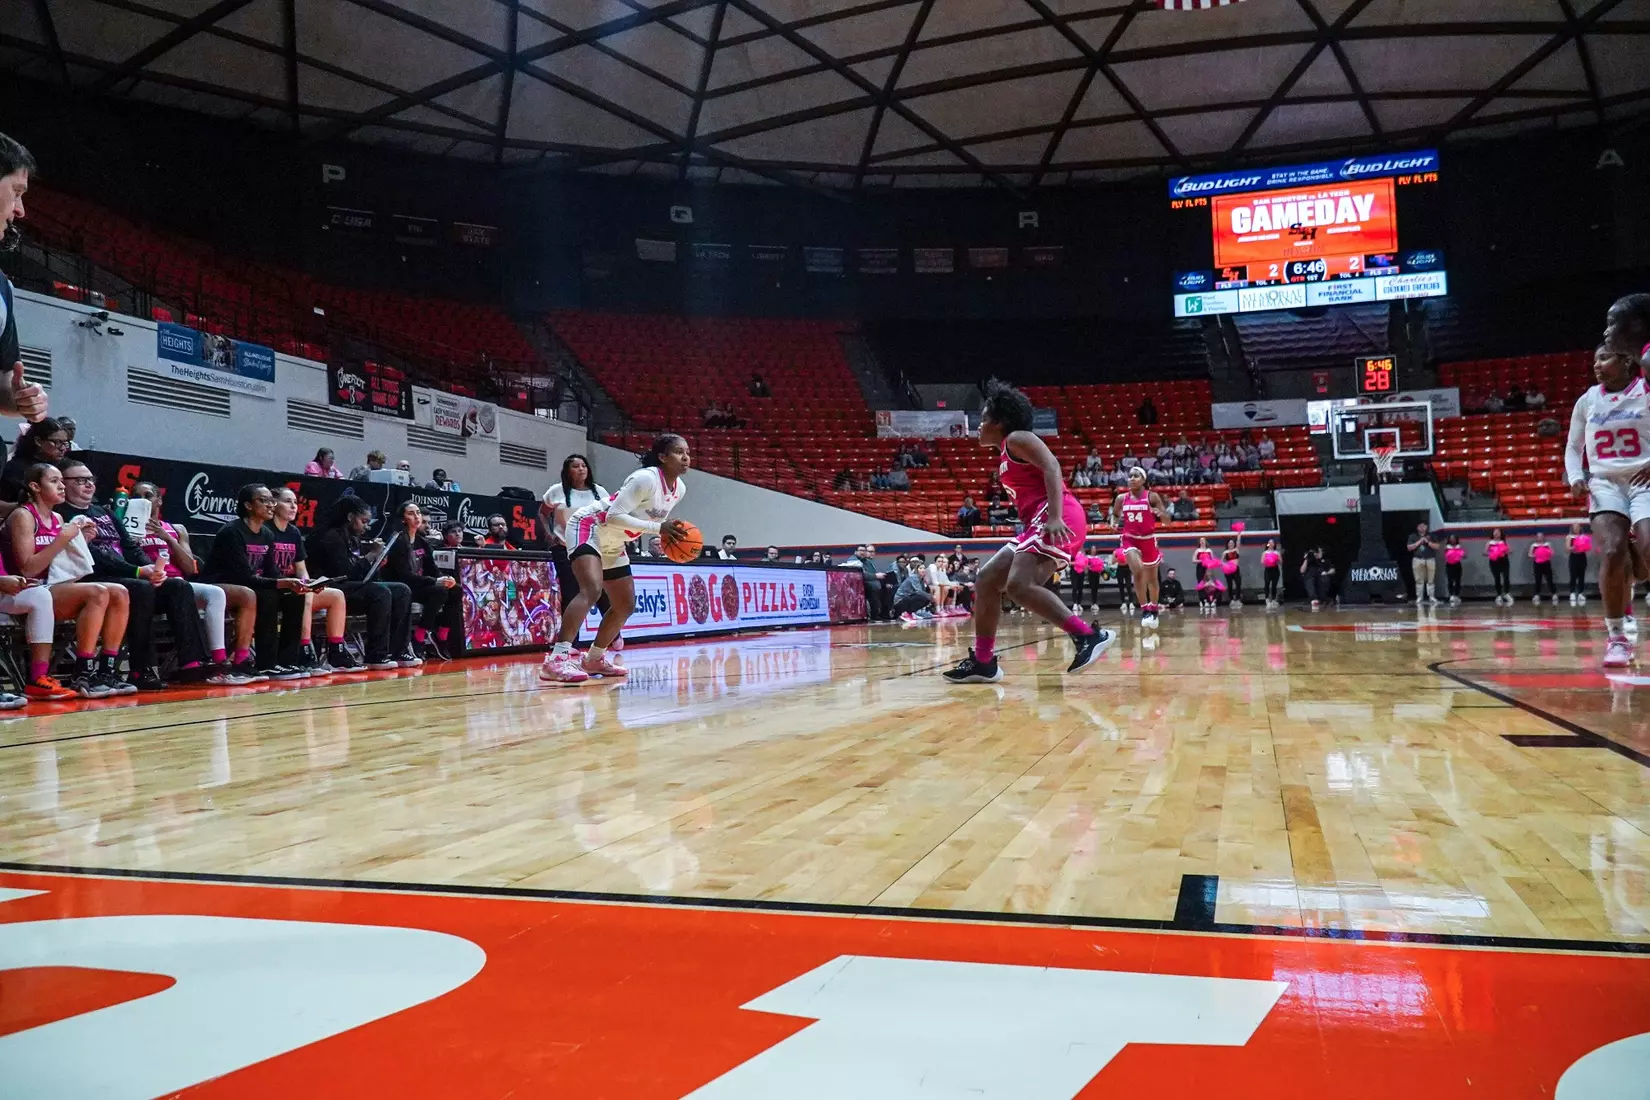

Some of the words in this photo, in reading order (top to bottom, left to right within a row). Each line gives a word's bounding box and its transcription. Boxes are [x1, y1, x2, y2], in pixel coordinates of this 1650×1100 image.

[1346, 164, 1383, 176] BUD
[1383, 156, 1434, 171] LIGHT
[1596, 149, 1625, 170] A
[322, 164, 346, 184] P
[1180, 180, 1214, 193] BUD
[1214, 176, 1261, 190] LIGHT
[1019, 211, 1039, 228] R
[1231, 193, 1375, 234] GAMEDAY
[1269, 264, 1278, 277] 2
[1294, 261, 1325, 275] 6:46
[1350, 257, 1360, 270] 2
[1242, 289, 1302, 301] MEMORIAL
[1318, 288, 1363, 298] FINANCIAL
[161, 336, 193, 352] HEIGHTS
[1367, 359, 1392, 372] 6:46
[1364, 371, 1390, 391] 28
[435, 415, 460, 430] REWARDS
[1594, 428, 1642, 460] 23
[411, 494, 450, 507] JOHNSON
[122, 517, 138, 528] 25
[1352, 566, 1398, 577] MEMORIAL
[1352, 574, 1398, 582] HERMANN
[802, 584, 814, 597] EVERY
[673, 574, 739, 625] BOGO
[742, 582, 798, 613] PIZZAS
